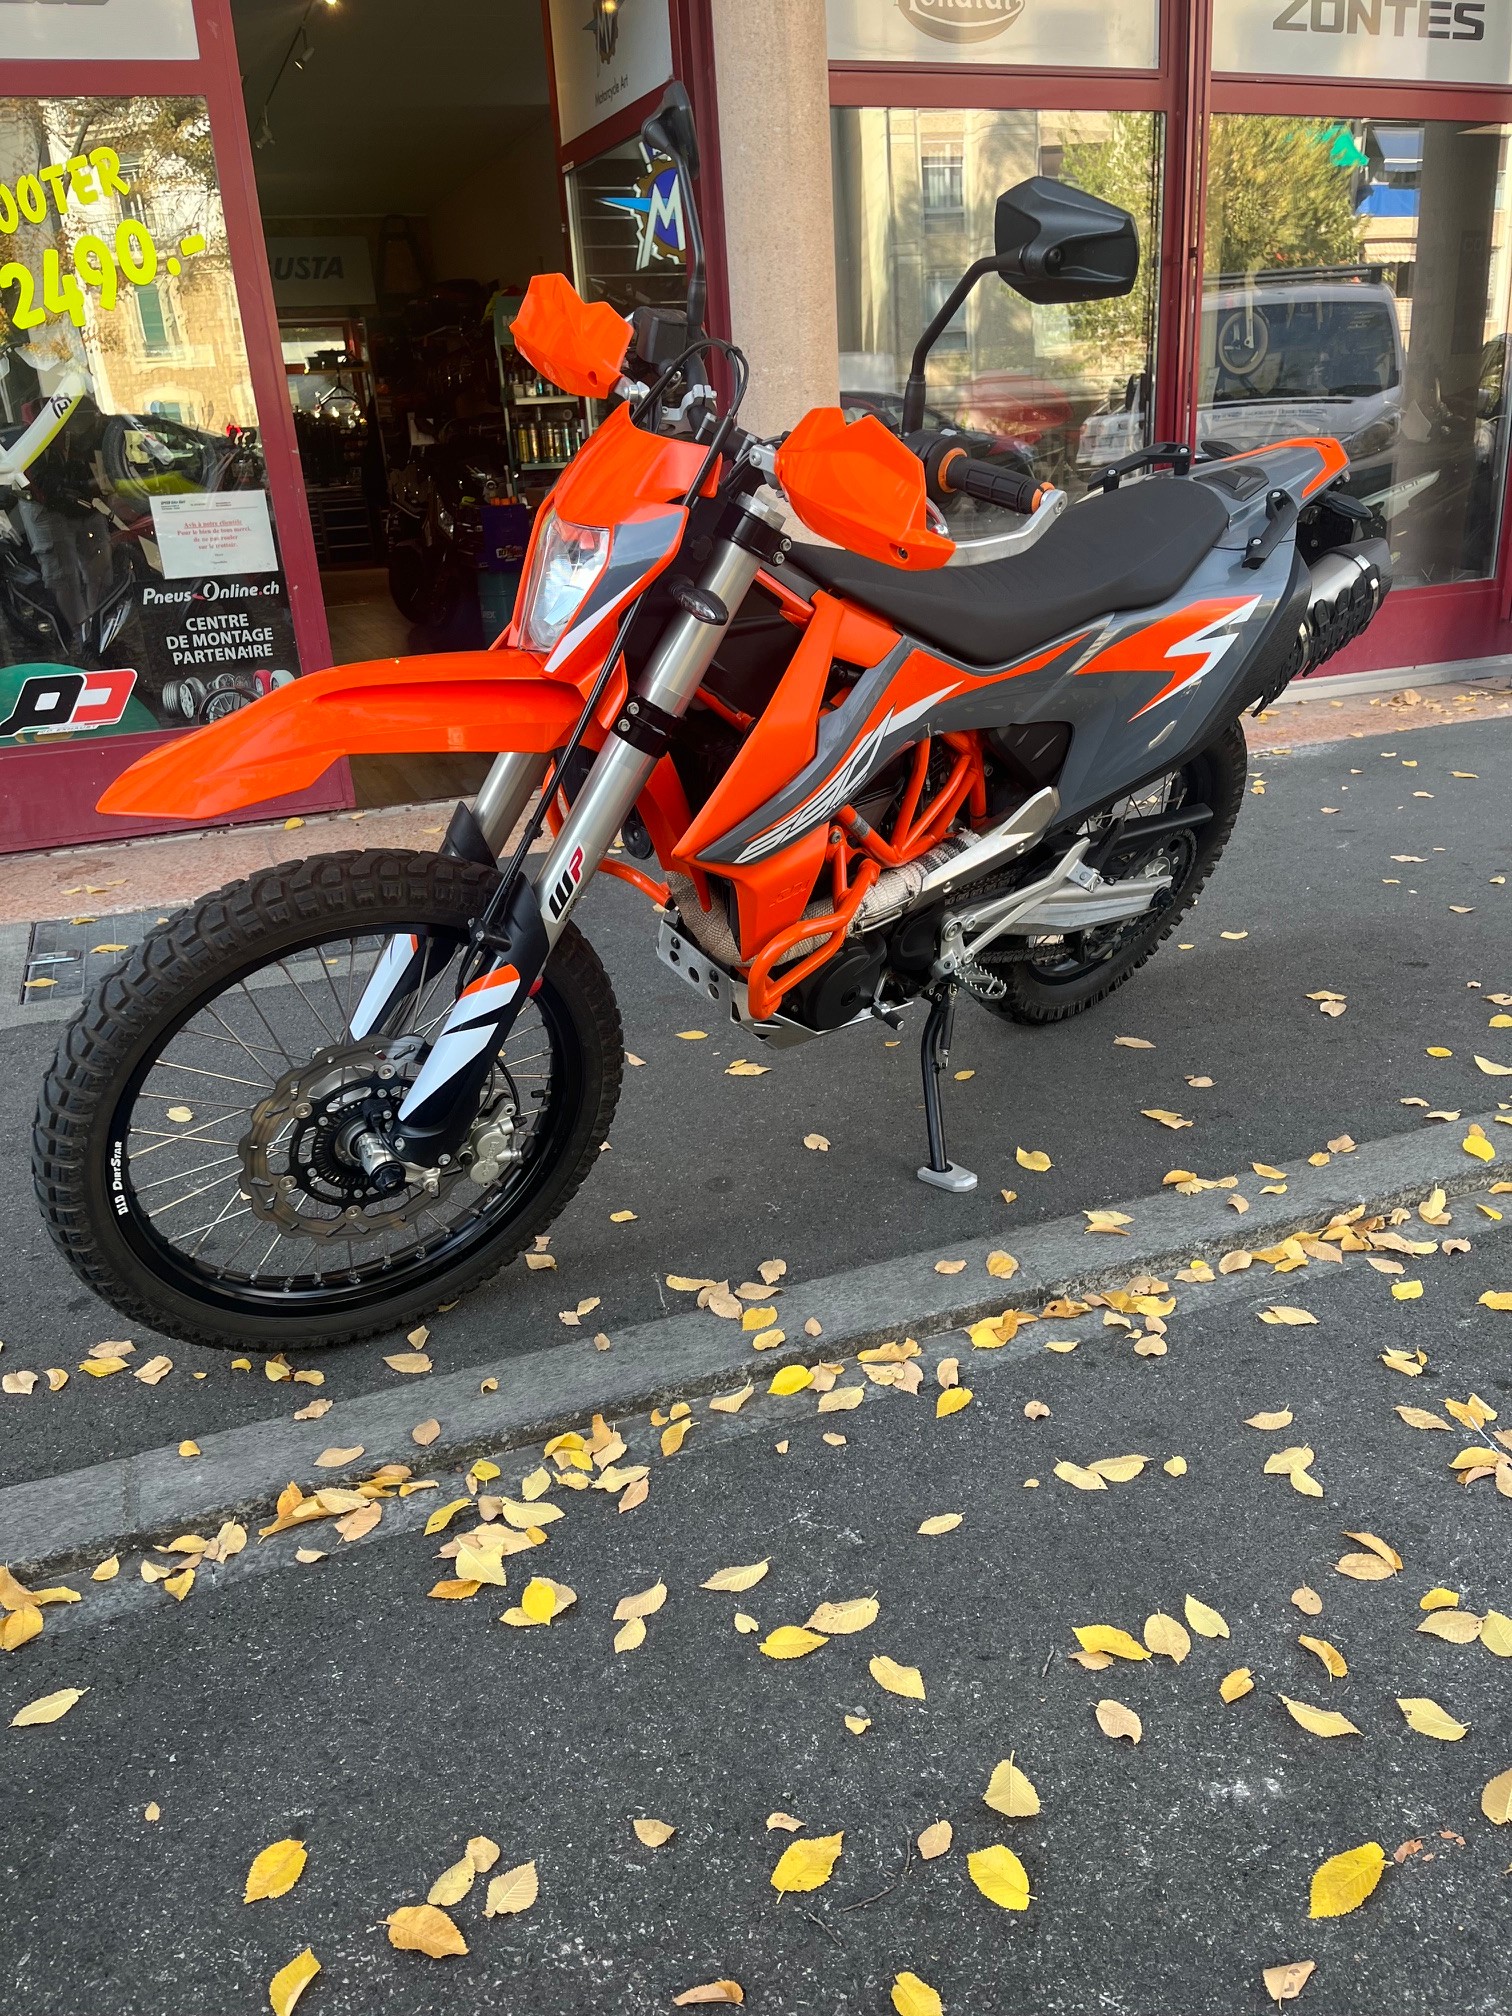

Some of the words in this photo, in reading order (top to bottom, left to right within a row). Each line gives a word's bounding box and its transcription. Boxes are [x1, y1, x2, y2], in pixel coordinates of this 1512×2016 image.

[1273, 0, 1485, 40] ZONTES
[274, 256, 344, 281] USTA
[185, 613, 249, 632] CENTRE
[165, 635, 189, 650] DE
[192, 627, 274, 648] MONTAGE
[172, 643, 274, 666] PARTENAIRE
[114, 1194, 129, 1216] DID
